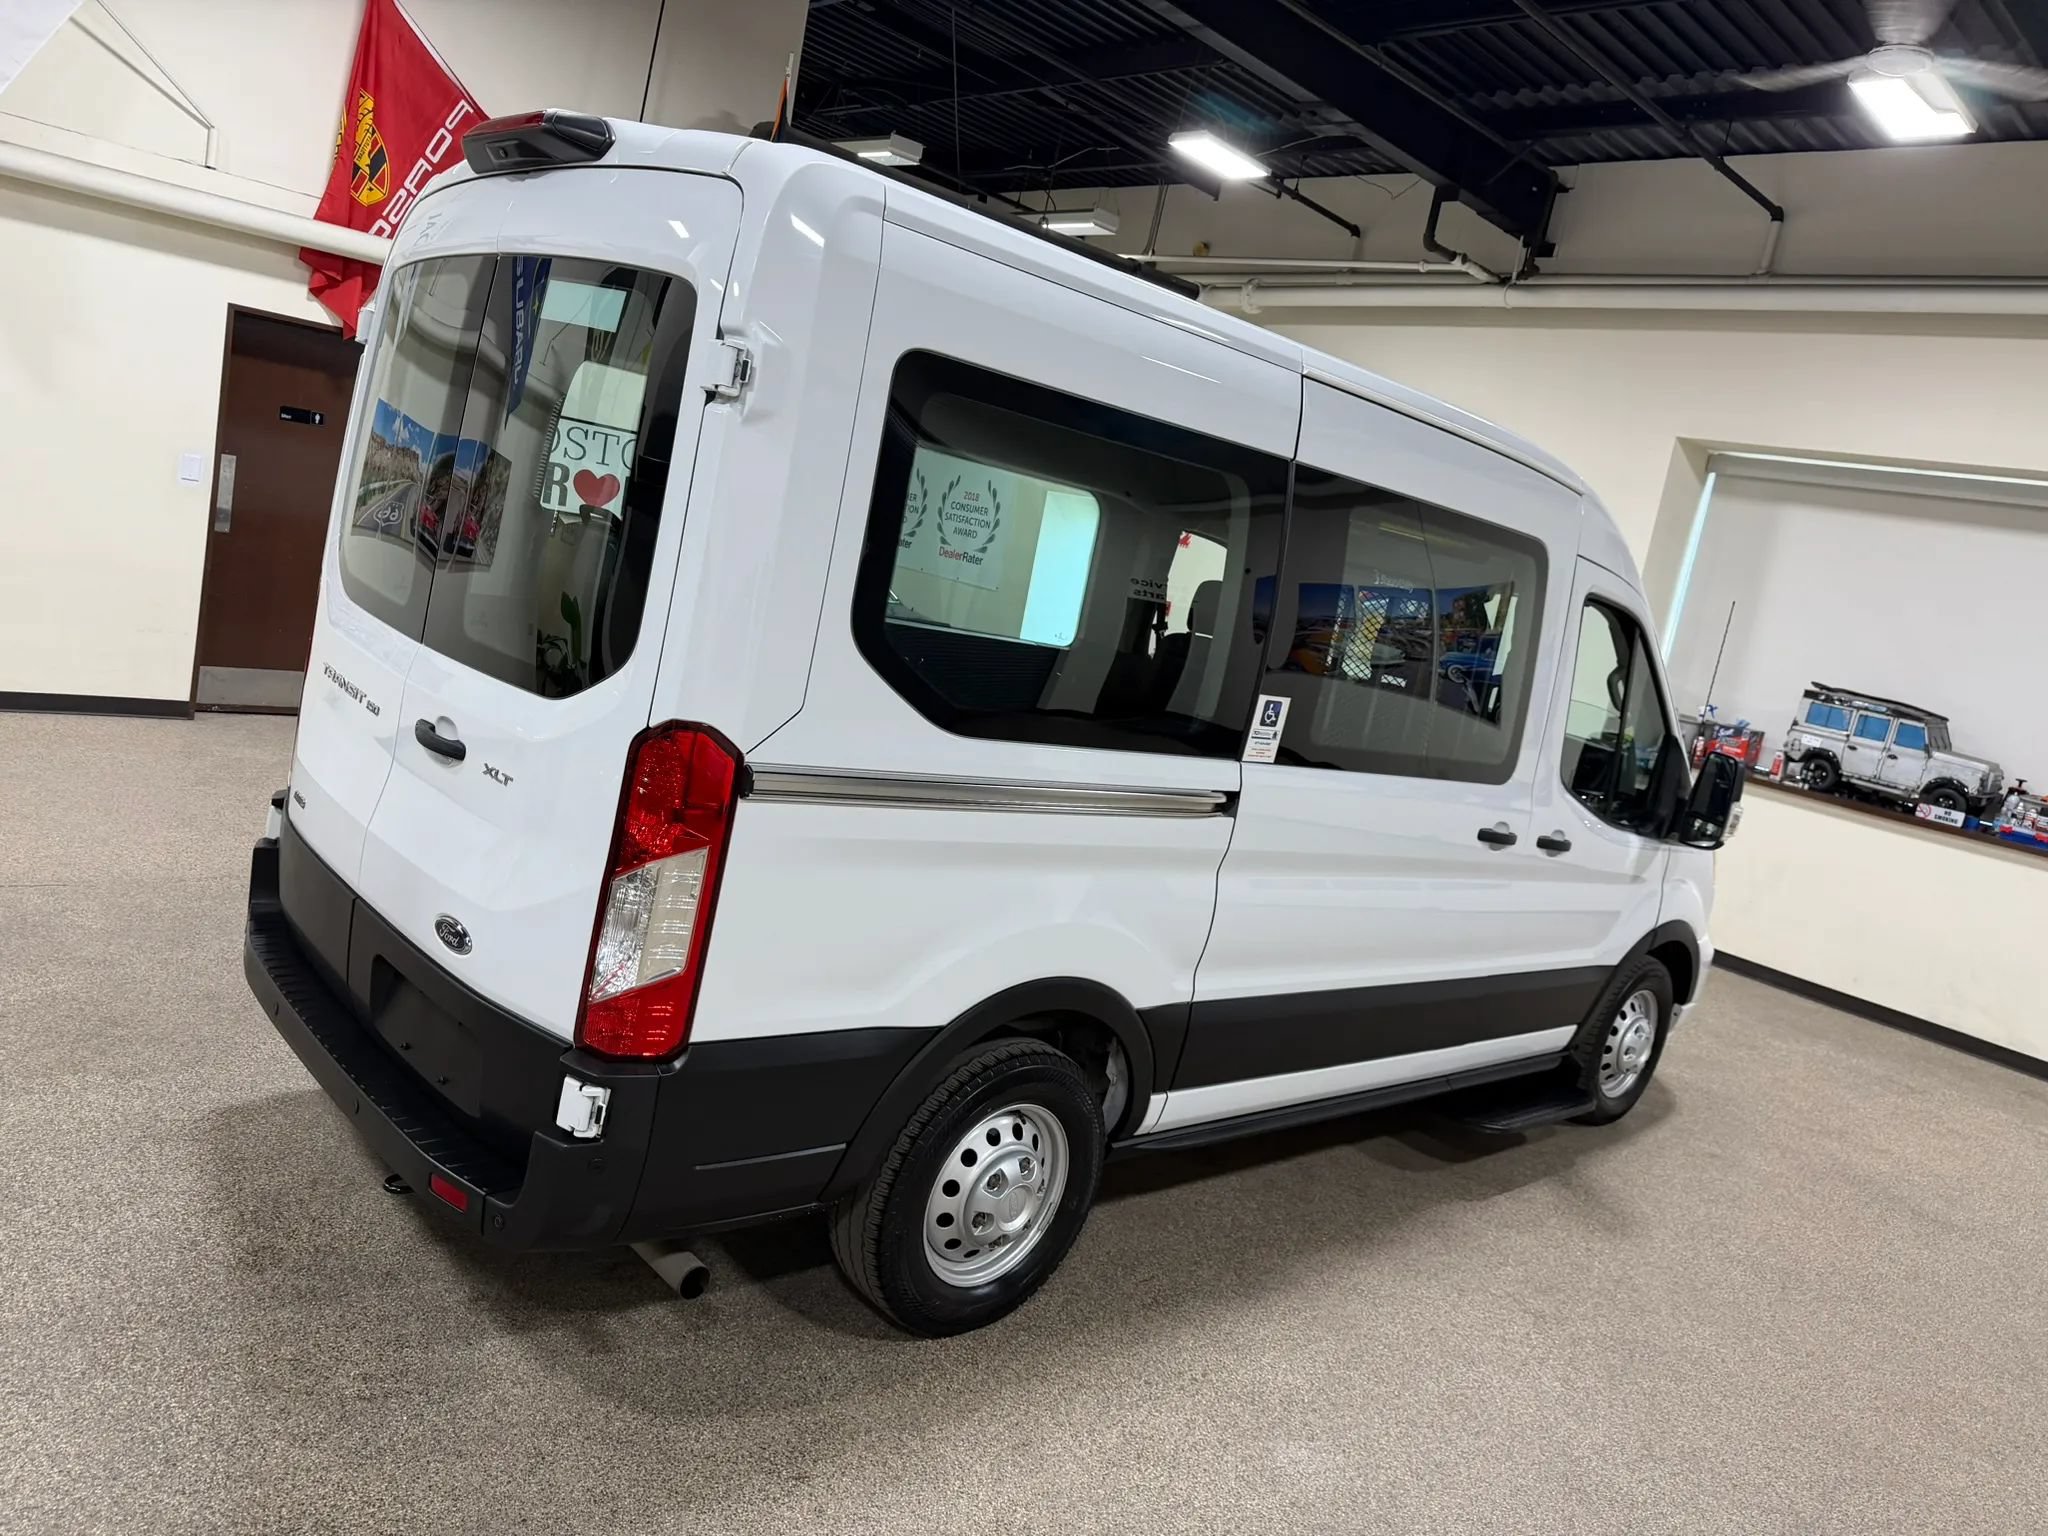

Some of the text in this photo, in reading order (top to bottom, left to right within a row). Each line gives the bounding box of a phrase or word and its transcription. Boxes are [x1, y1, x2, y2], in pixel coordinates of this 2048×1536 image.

[963, 491, 980, 502] 2018
[950, 501, 989, 516] CONSUMER
[944, 512, 991, 529] SATISFACTION
[952, 527, 978, 539] AWARD
[939, 546, 984, 565] DealerRater
[323, 662, 367, 704] TRANSIT
[482, 763, 514, 786] XLT
[439, 923, 461, 947] Ford
